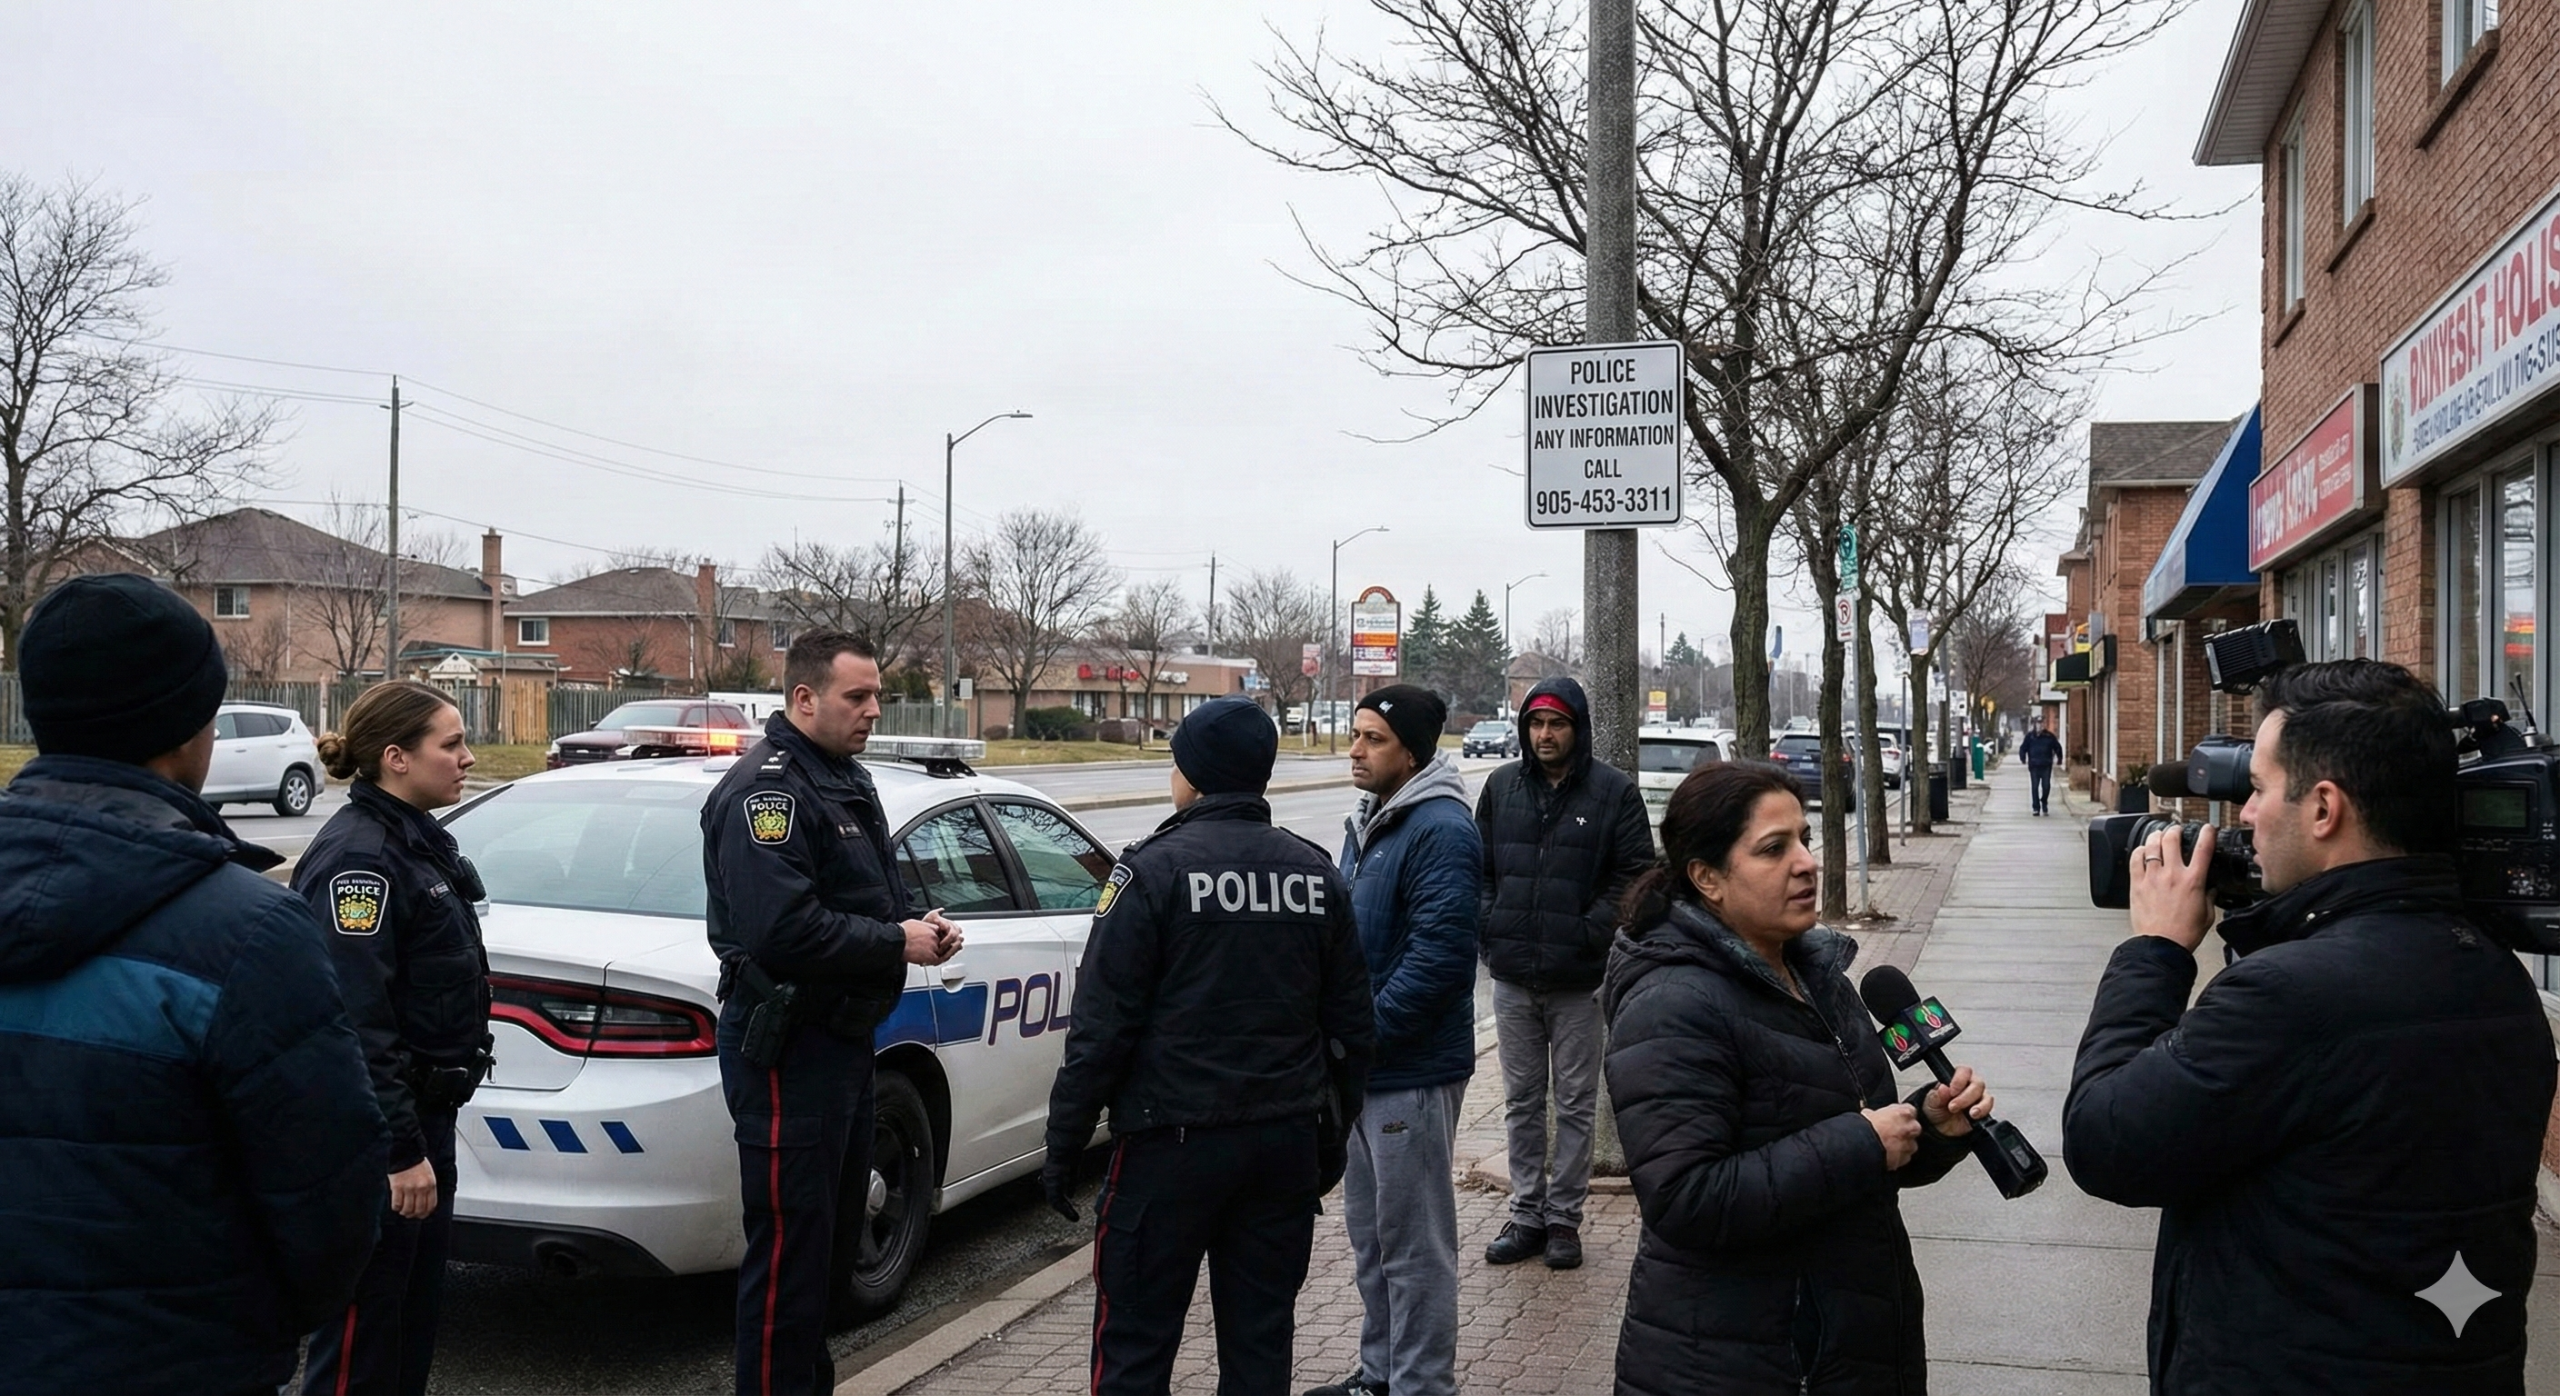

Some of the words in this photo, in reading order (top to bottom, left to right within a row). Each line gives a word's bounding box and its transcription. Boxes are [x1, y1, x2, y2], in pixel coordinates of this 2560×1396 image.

[1571, 359, 1635, 385] POLICE
[1535, 389, 1673, 419] INVESTIGATION
[1534, 429, 1565, 450] ANY
[1569, 424, 1674, 449] INFORMATION
[1584, 458, 1622, 479] CALL
[1536, 486, 1670, 515] 905-453-3311
[337, 885, 381, 896] POLICE
[1188, 871, 1326, 915] POLICE
